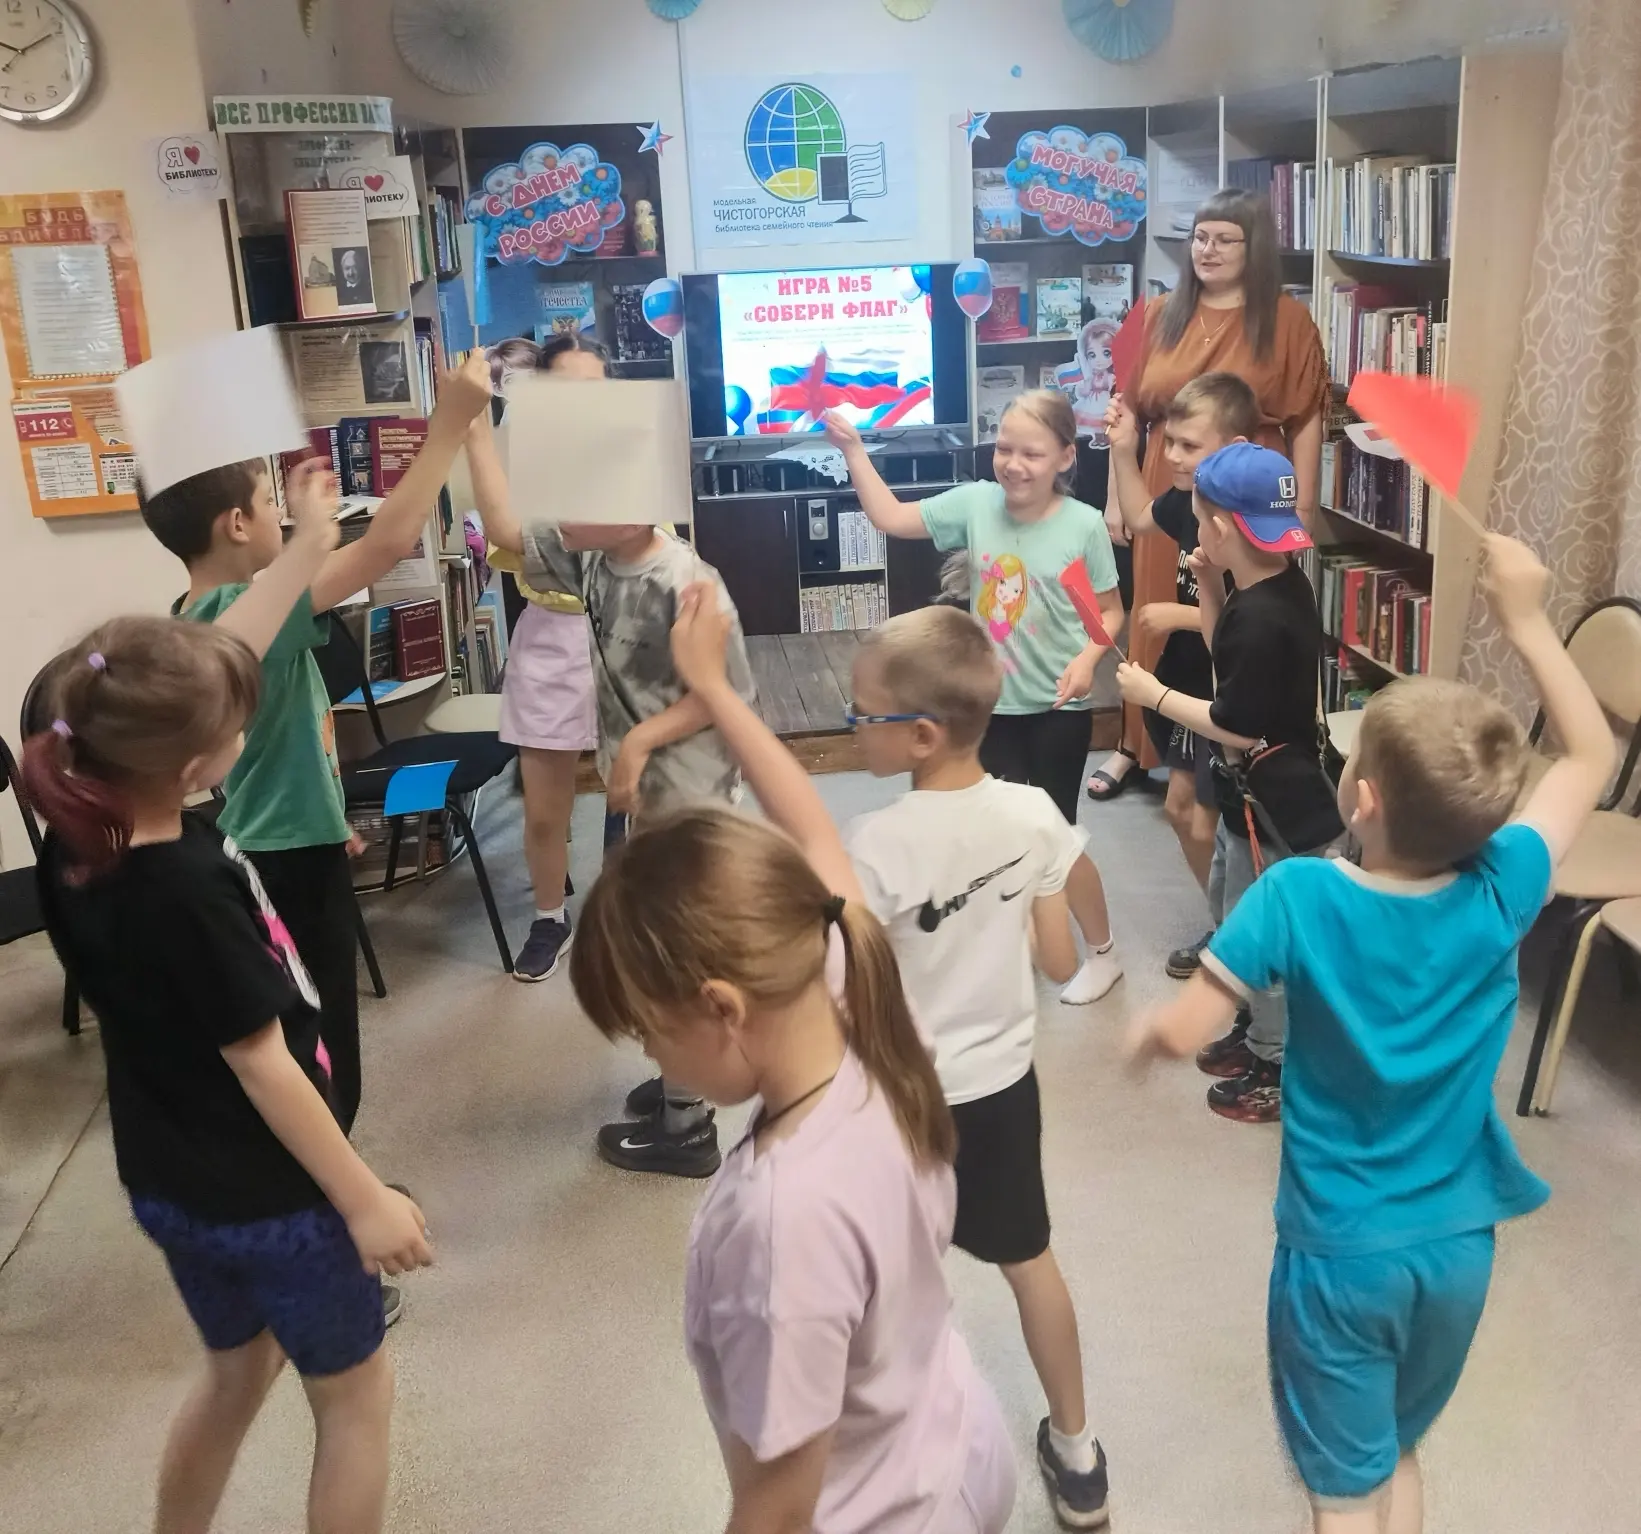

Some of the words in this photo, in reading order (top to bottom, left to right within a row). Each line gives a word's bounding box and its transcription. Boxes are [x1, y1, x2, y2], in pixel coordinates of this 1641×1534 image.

[216, 102, 252, 125] ВСЕ
[166, 147, 183, 168] Я
[165, 167, 218, 181] БИБЛИОТЕКУ
[1030, 144, 1137, 195] МОГУЧАЯ
[365, 192, 404, 204] ЛИОТЕКУ
[486, 194, 506, 217] С
[512, 162, 582, 209] ДНЕМ
[713, 197, 757, 206] модельная
[1029, 185, 1114, 230] СТРАНА
[26, 210, 85, 224] БУДЬ
[713, 205, 806, 222] ЧИСТОГОРСКАЯ
[498, 200, 601, 258] РОССИИ
[715, 222, 761, 233] библиотека
[762, 220, 805, 231] семейного
[777, 276, 831, 295] ИГРА
[838, 275, 872, 293] №5
[842, 299, 908, 319] ФЛАГ»
[29, 418, 59, 432] 112
[1269, 499, 1297, 509] HOND
